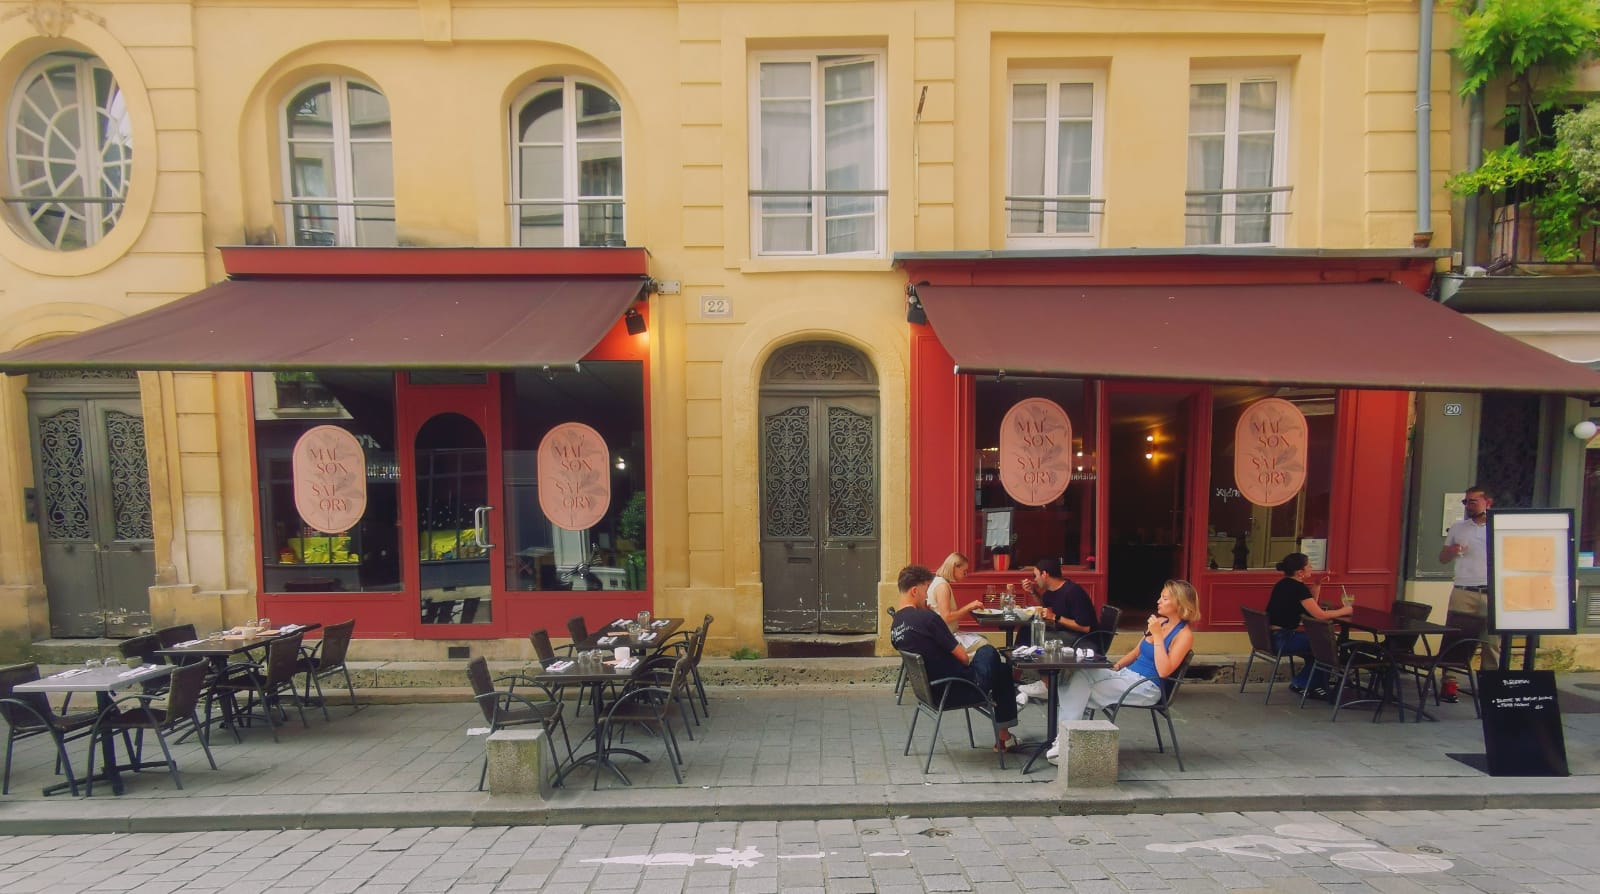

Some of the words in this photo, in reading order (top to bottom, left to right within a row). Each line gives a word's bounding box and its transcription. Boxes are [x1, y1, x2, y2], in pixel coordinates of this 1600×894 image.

[707, 300, 725, 313] 22
[1446, 405, 1460, 414] 20
[1023, 434, 1055, 447] SON
[1258, 435, 1291, 448] SON
[316, 462, 349, 474] SON
[561, 459, 593, 472] SON
[1023, 471, 1055, 484] ORY
[1258, 472, 1289, 485] ORY
[319, 499, 349, 511] ORY
[562, 496, 593, 509] ORY
